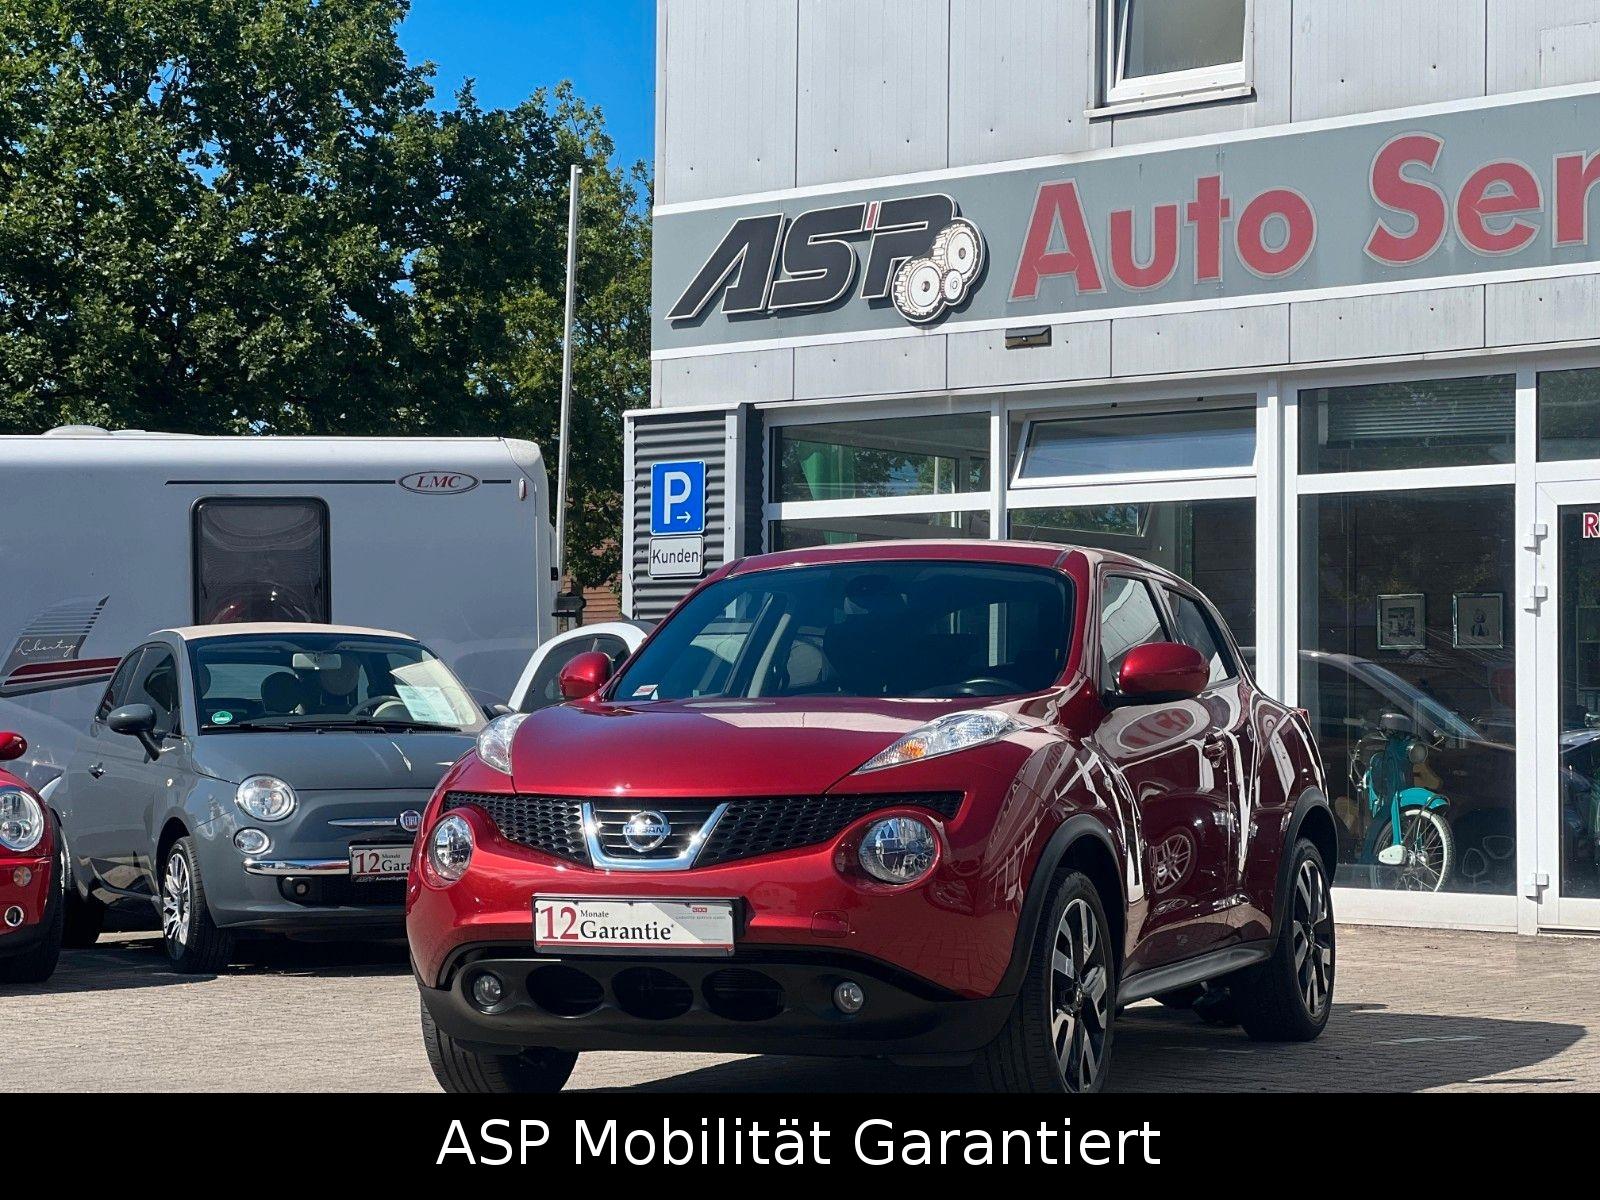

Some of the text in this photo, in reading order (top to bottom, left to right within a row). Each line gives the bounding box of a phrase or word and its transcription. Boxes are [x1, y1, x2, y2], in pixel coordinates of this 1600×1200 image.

[1009, 174, 1318, 300] Auto
[665, 193, 958, 320] ASP
[416, 475, 461, 488] LMC
[663, 471, 692, 525] P
[1583, 512, 1600, 538] R
[652, 548, 699, 564] Kunden
[626, 826, 665, 834] NISAN
[355, 853, 381, 874] 12
[540, 906, 579, 940] 12
[580, 909, 609, 918] Monate
